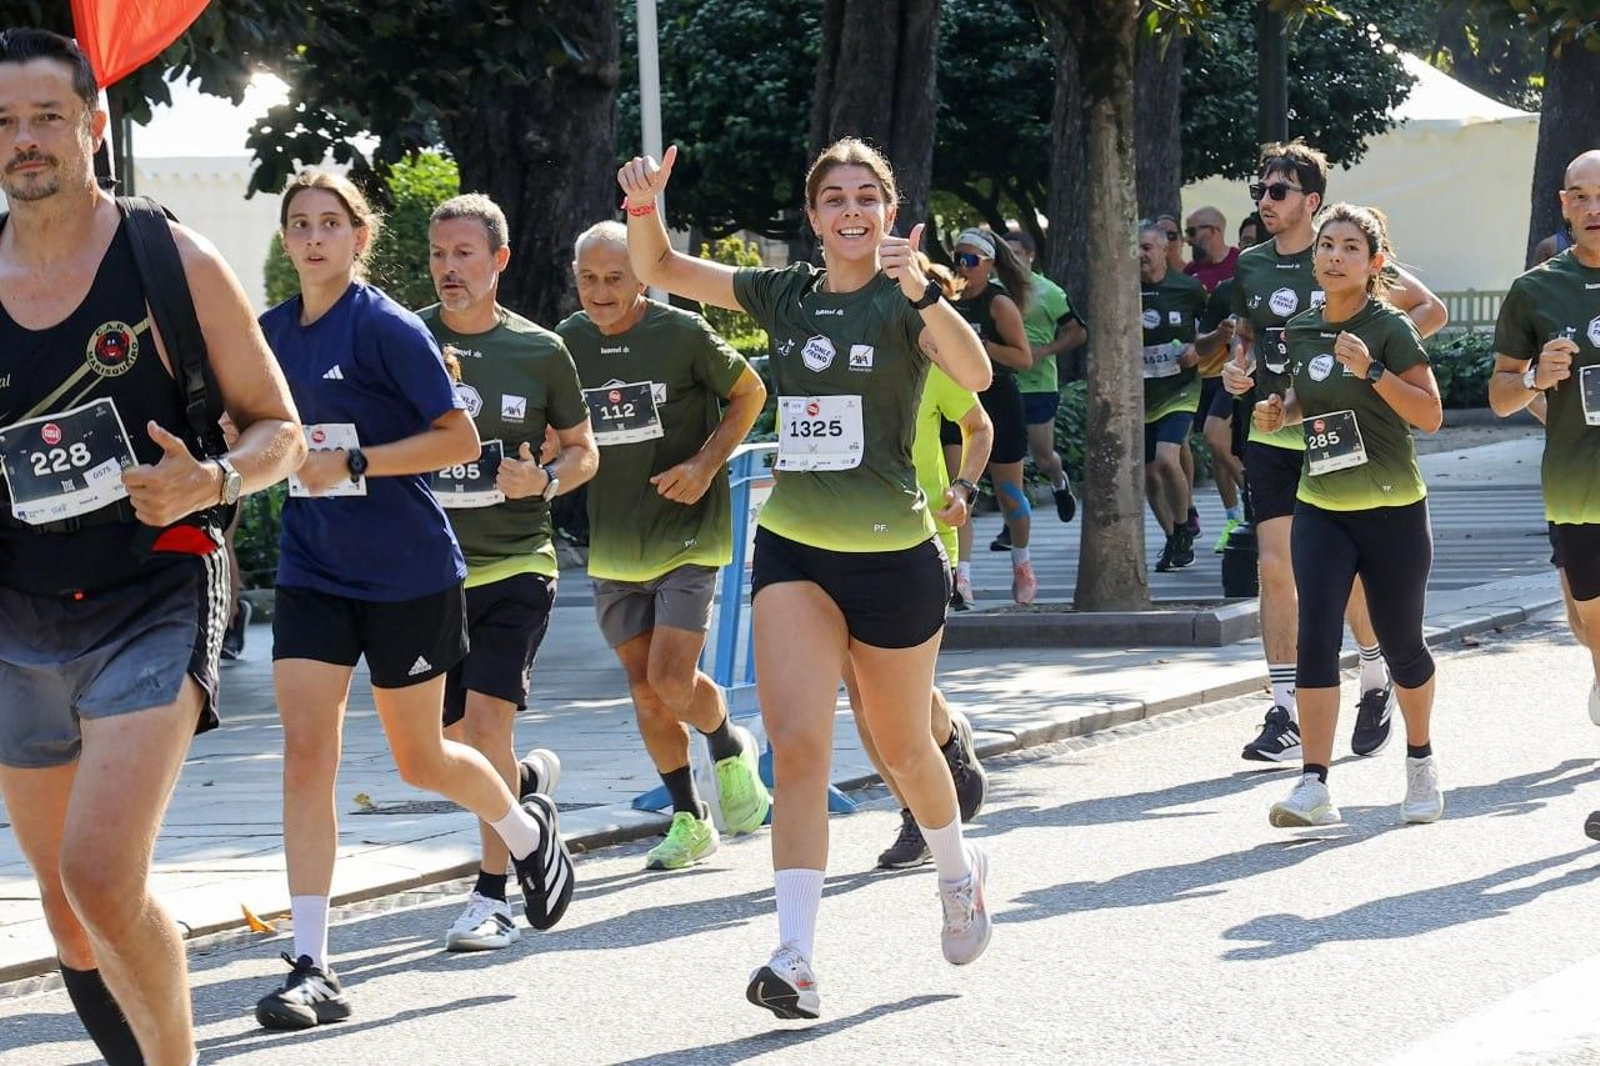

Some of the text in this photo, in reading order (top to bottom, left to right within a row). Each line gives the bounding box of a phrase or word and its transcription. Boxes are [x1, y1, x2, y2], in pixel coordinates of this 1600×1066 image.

[810, 342, 832, 357] PONLE
[600, 402, 636, 420] 112
[790, 420, 843, 438] 1325
[1308, 431, 1341, 450] 285
[30, 442, 92, 477] 228
[438, 464, 481, 480] 205
[874, 524, 888, 532] PF.
